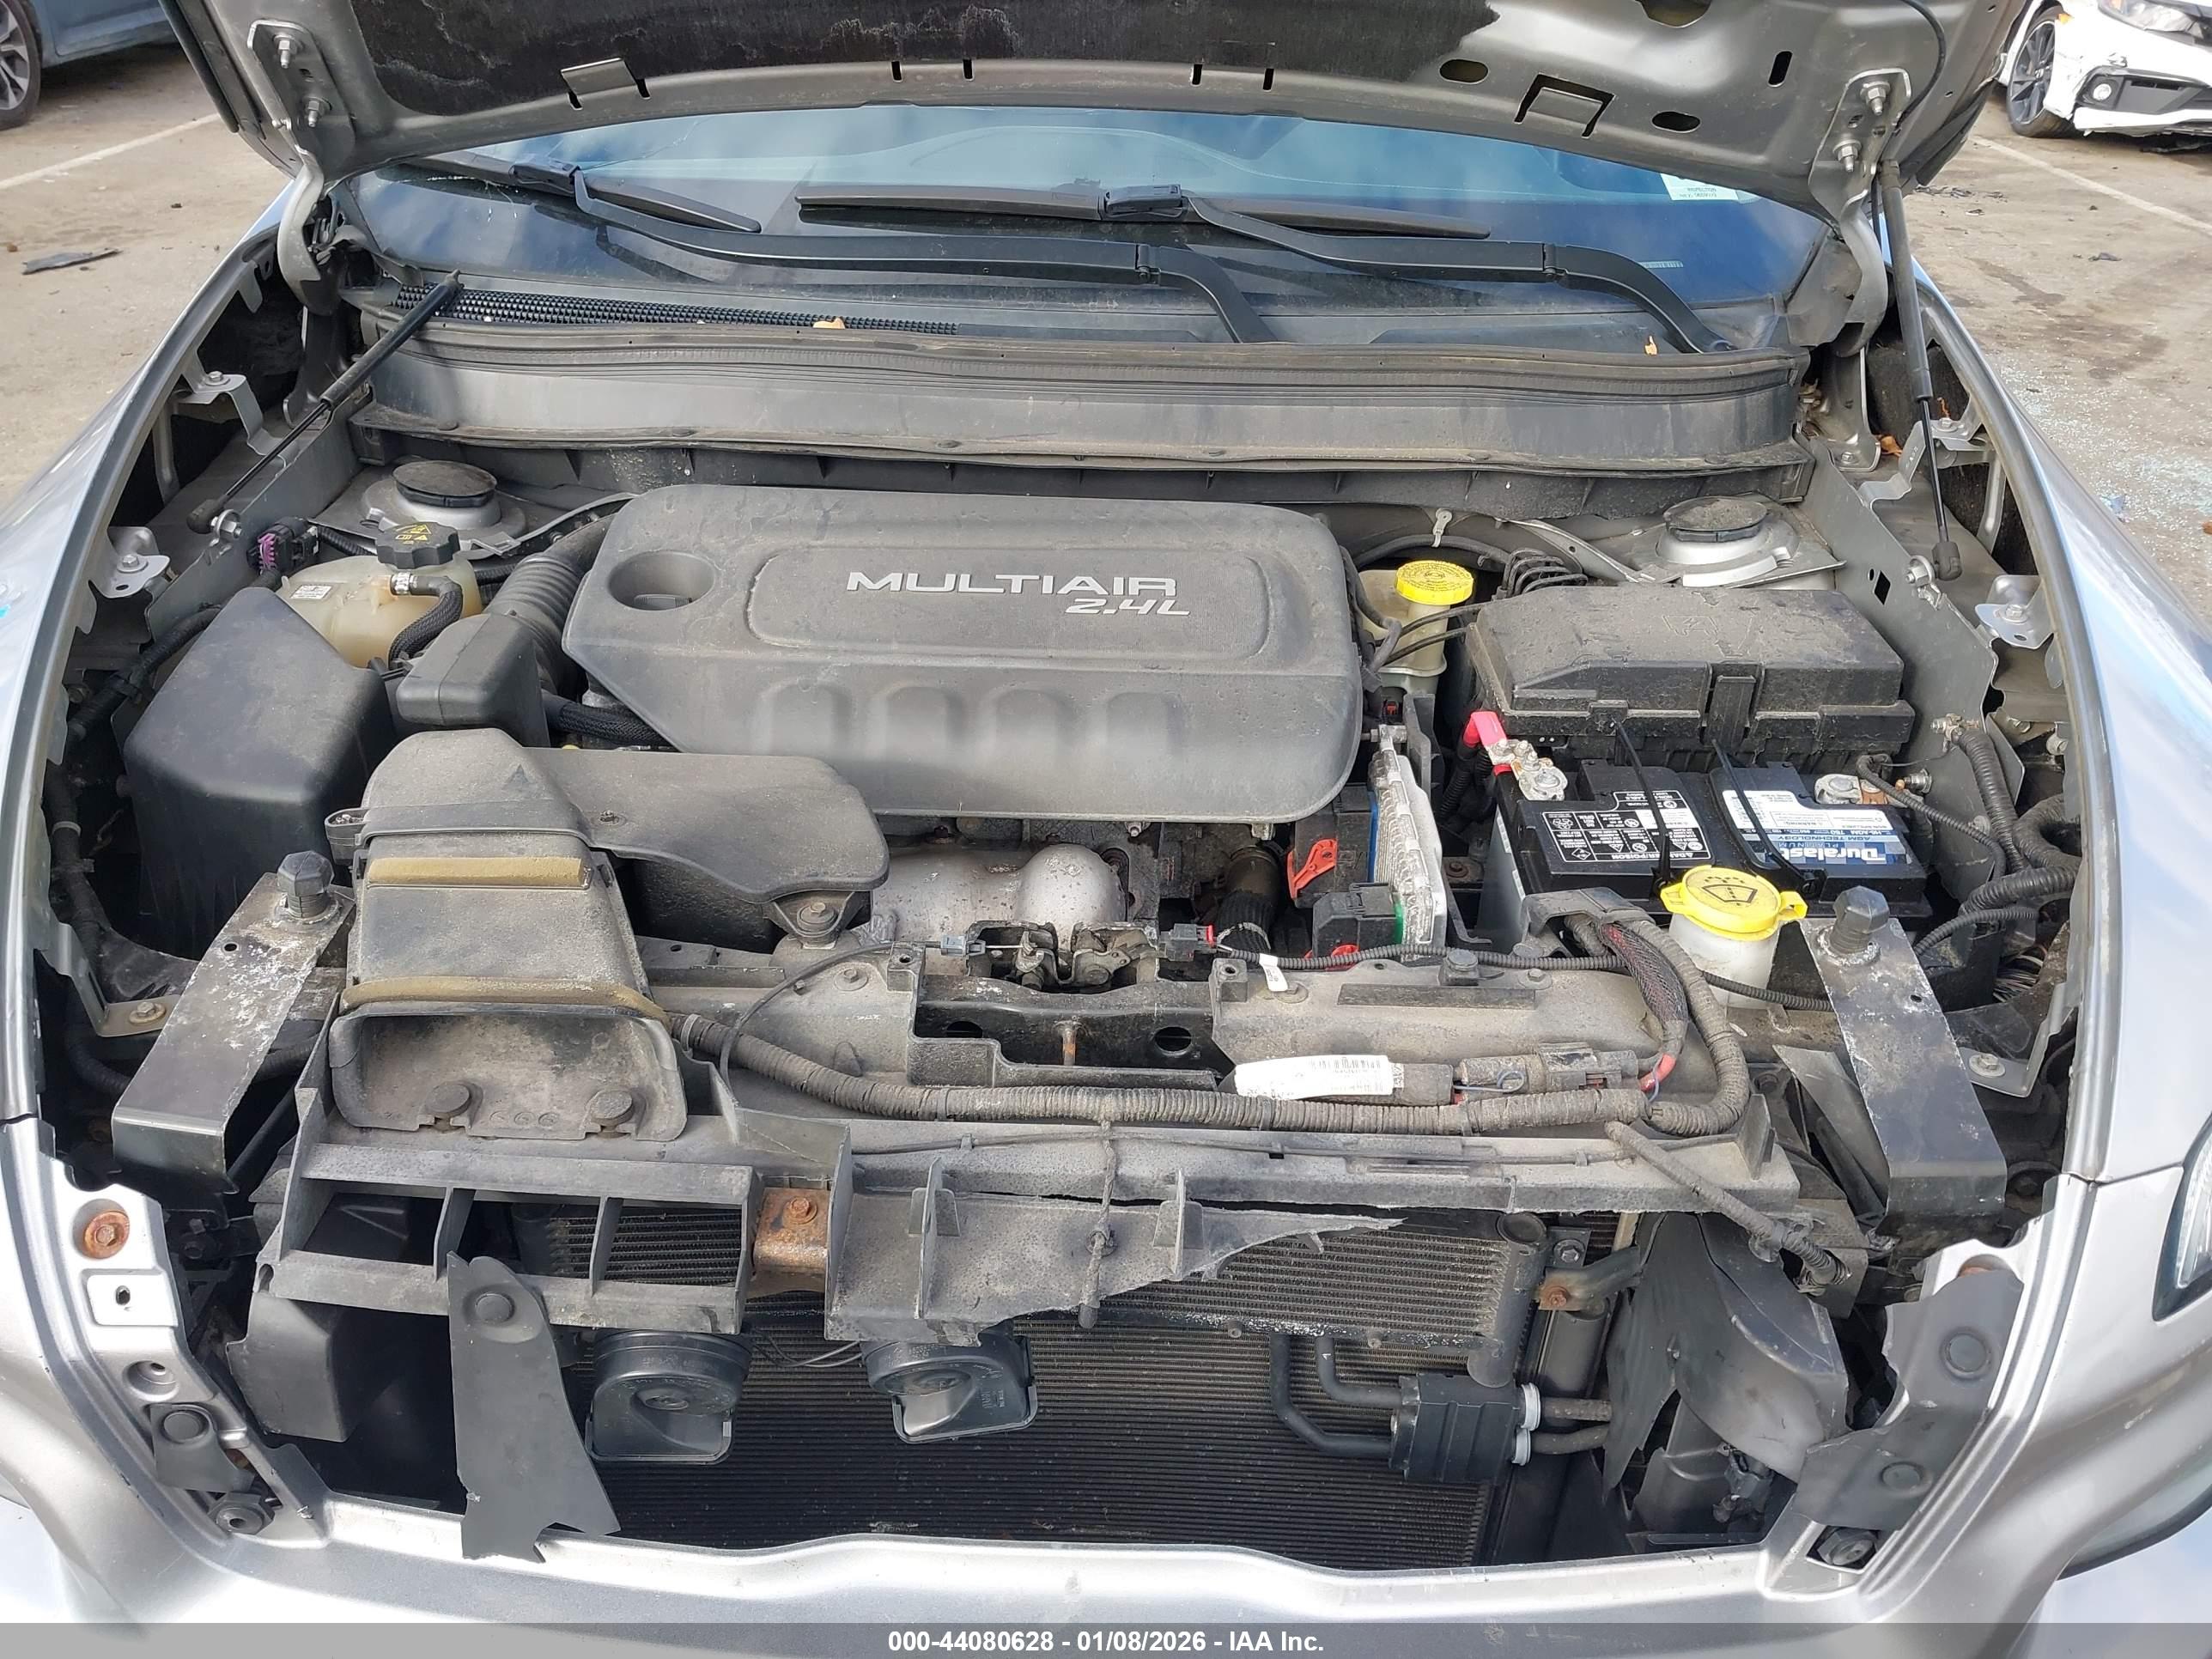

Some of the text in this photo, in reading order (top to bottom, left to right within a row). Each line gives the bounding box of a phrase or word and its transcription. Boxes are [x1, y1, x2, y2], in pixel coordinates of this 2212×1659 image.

[847, 572, 1176, 596] MULTIAIR
[1065, 598, 1190, 615] 2.4L
[1779, 848, 1887, 861] Duralast
